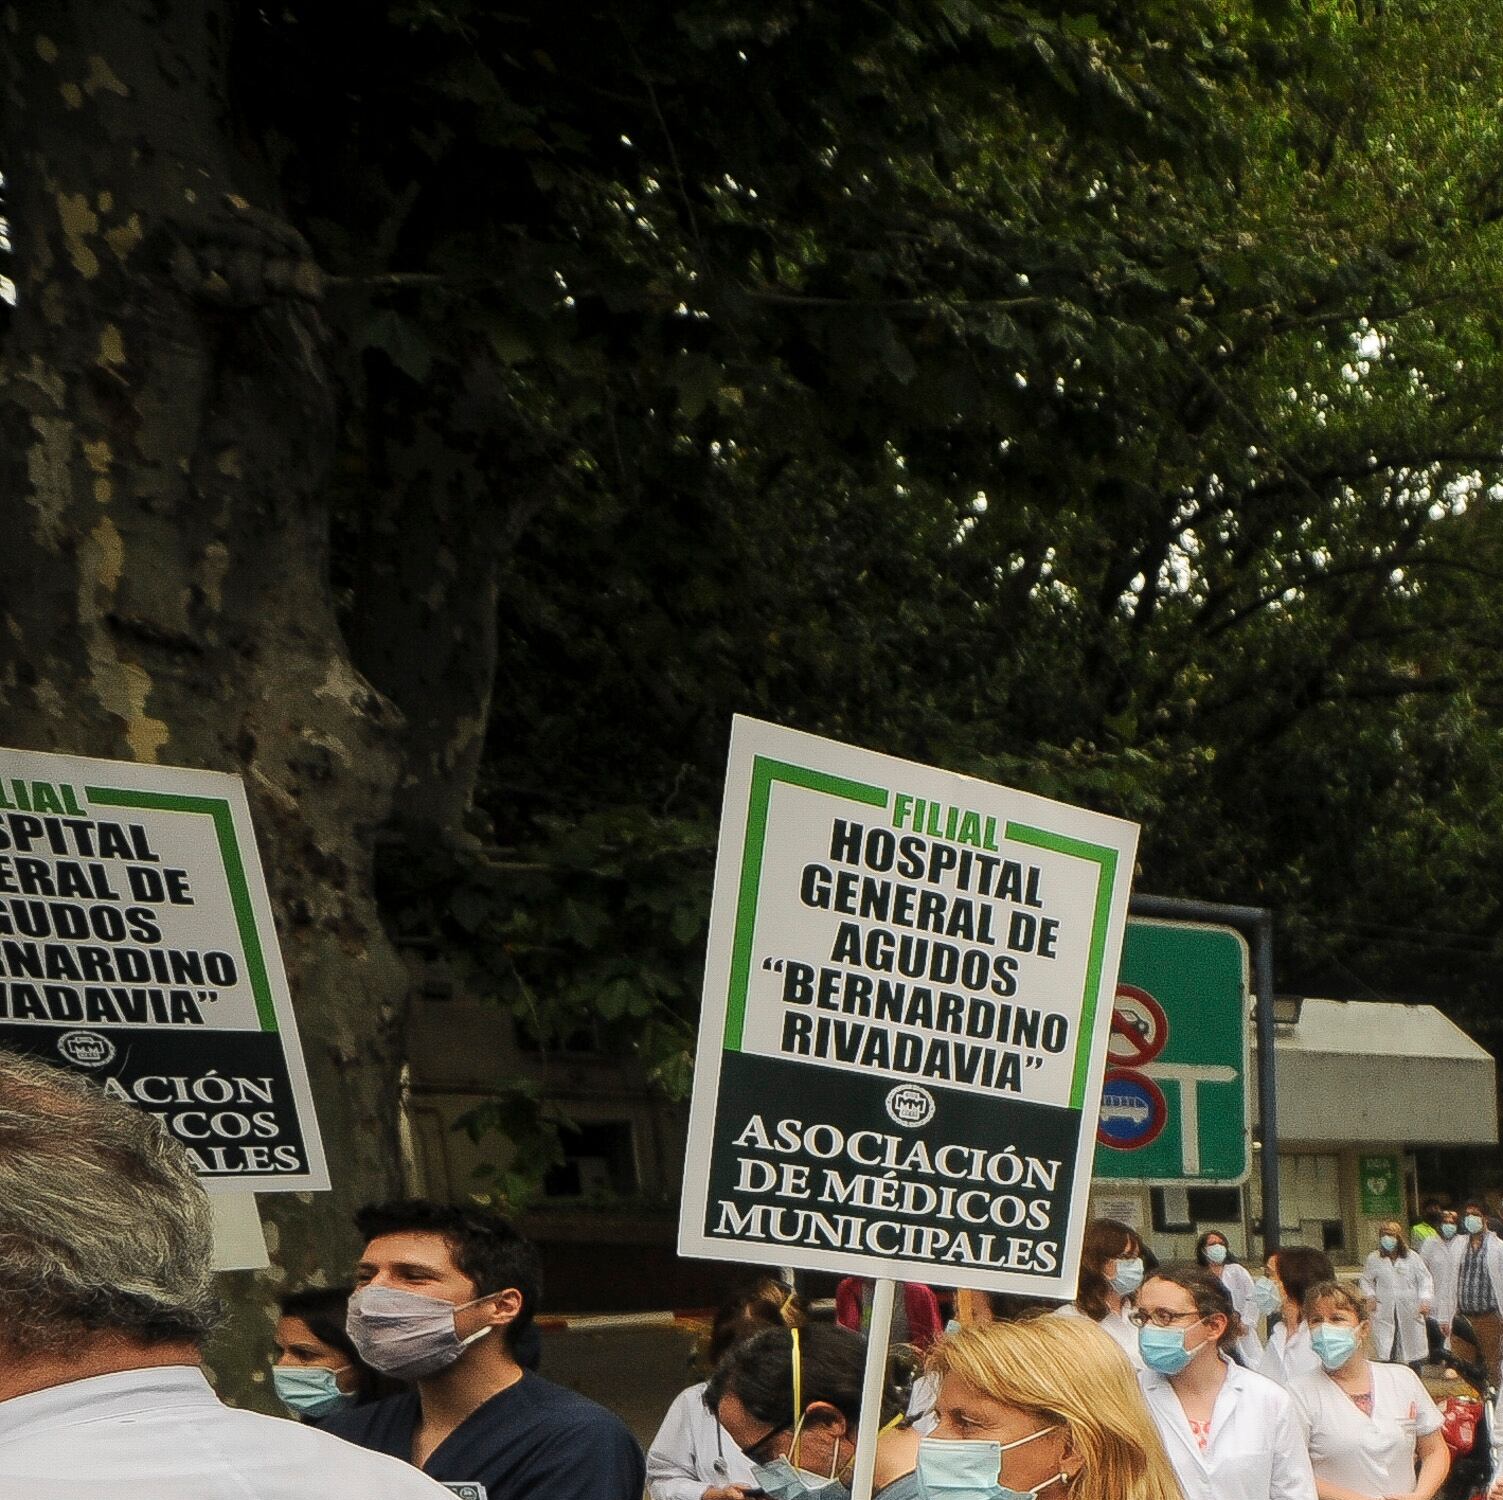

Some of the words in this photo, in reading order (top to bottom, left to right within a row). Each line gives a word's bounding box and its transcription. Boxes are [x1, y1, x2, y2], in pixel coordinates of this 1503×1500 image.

[892, 792, 999, 851] FILIAL
[126, 866, 194, 905] DE
[830, 818, 1042, 908] HOSPITAL
[800, 864, 995, 945] GENERAL
[1007, 911, 1060, 960] DE
[0, 940, 238, 986] NARDINO
[830, 921, 1019, 998] AGUDOS
[732, 1115, 1062, 1191] ASOCIACIÓN
[733, 1157, 811, 1199] DE
[818, 1169, 1051, 1231] MÉDICOS
[713, 1200, 1057, 1272] MUNICIPALES
